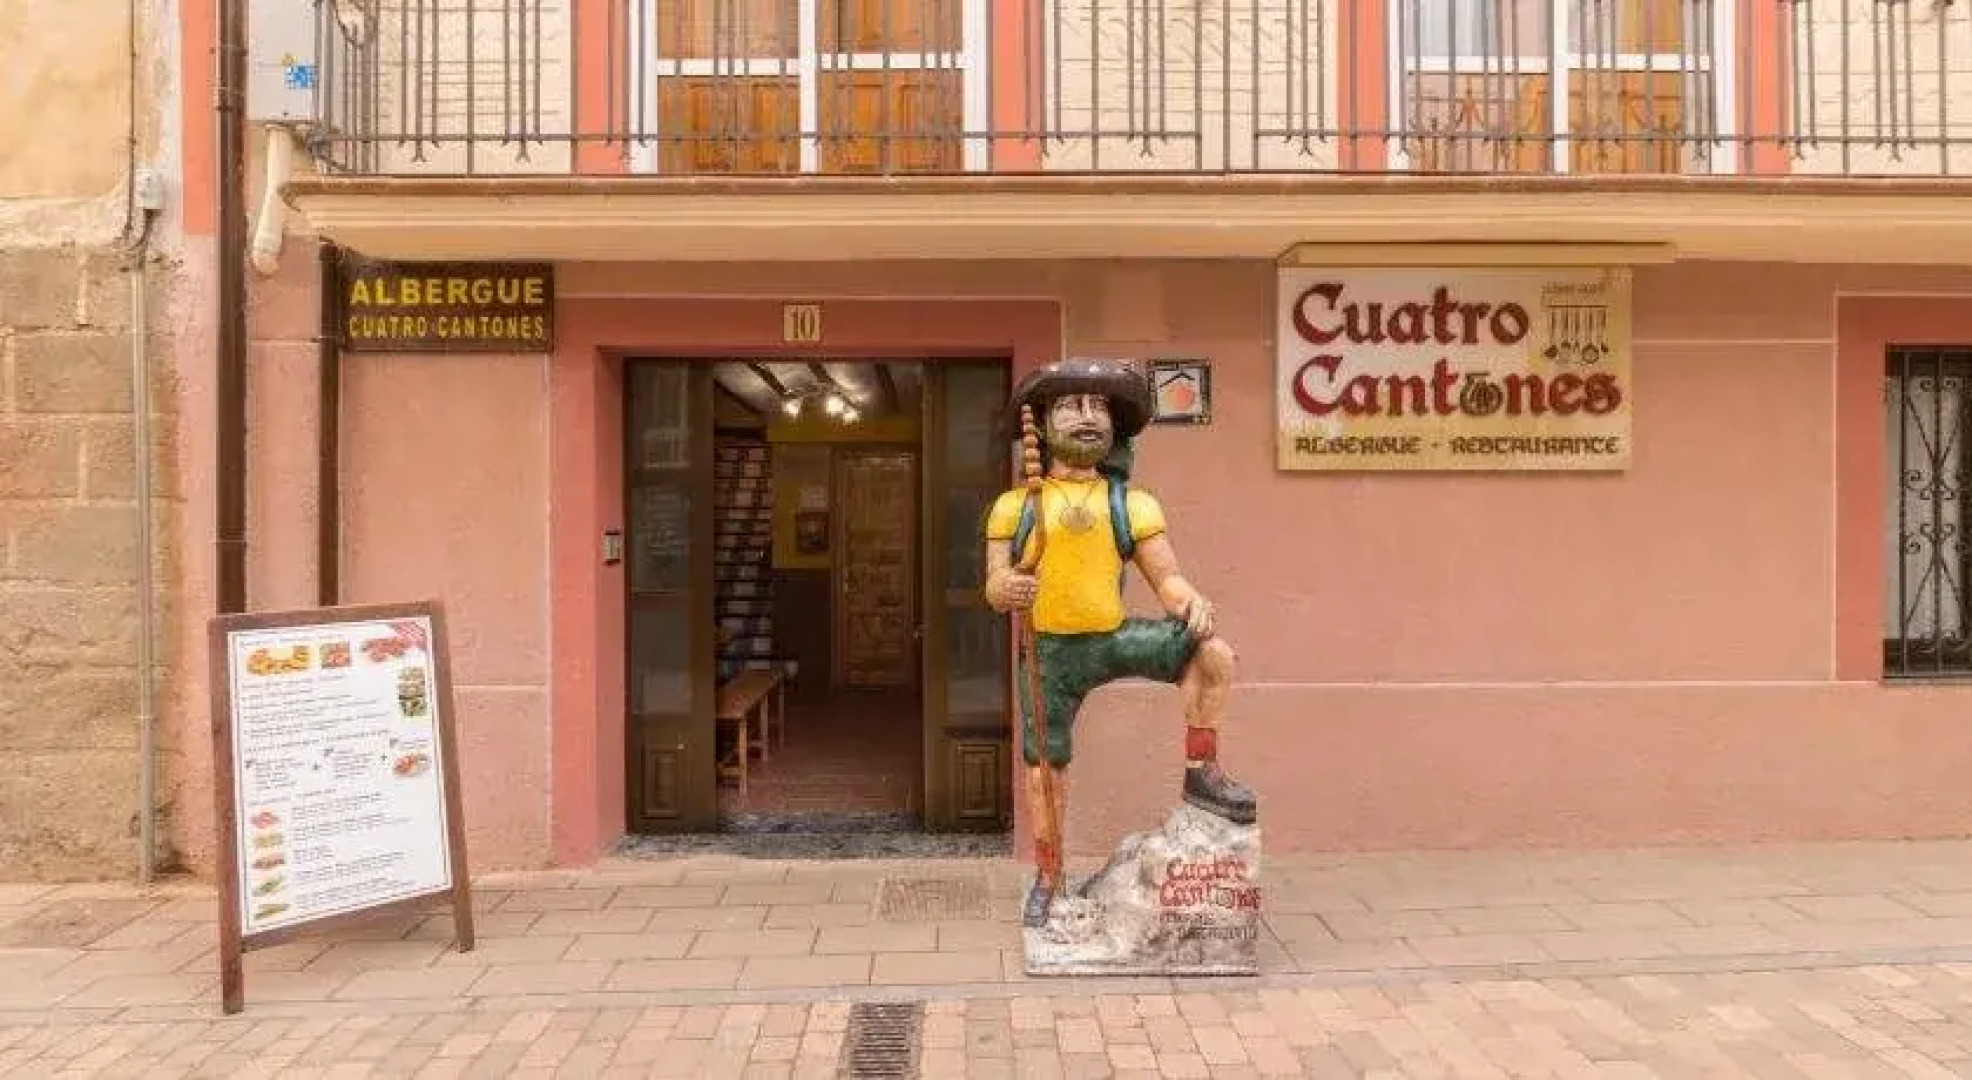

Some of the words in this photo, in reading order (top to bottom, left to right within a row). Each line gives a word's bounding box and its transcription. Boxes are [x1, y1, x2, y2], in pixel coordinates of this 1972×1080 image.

[351, 278, 544, 304] ALBERGUE
[350, 316, 427, 338] CUATRO
[438, 316, 544, 338] CANTONES
[790, 307, 816, 339] 10
[1293, 283, 1530, 345] Cuatro
[1293, 355, 1622, 416] Cantones
[1295, 436, 1421, 456] ALBERGUE
[1449, 436, 1619, 456] RESTAURANTE
